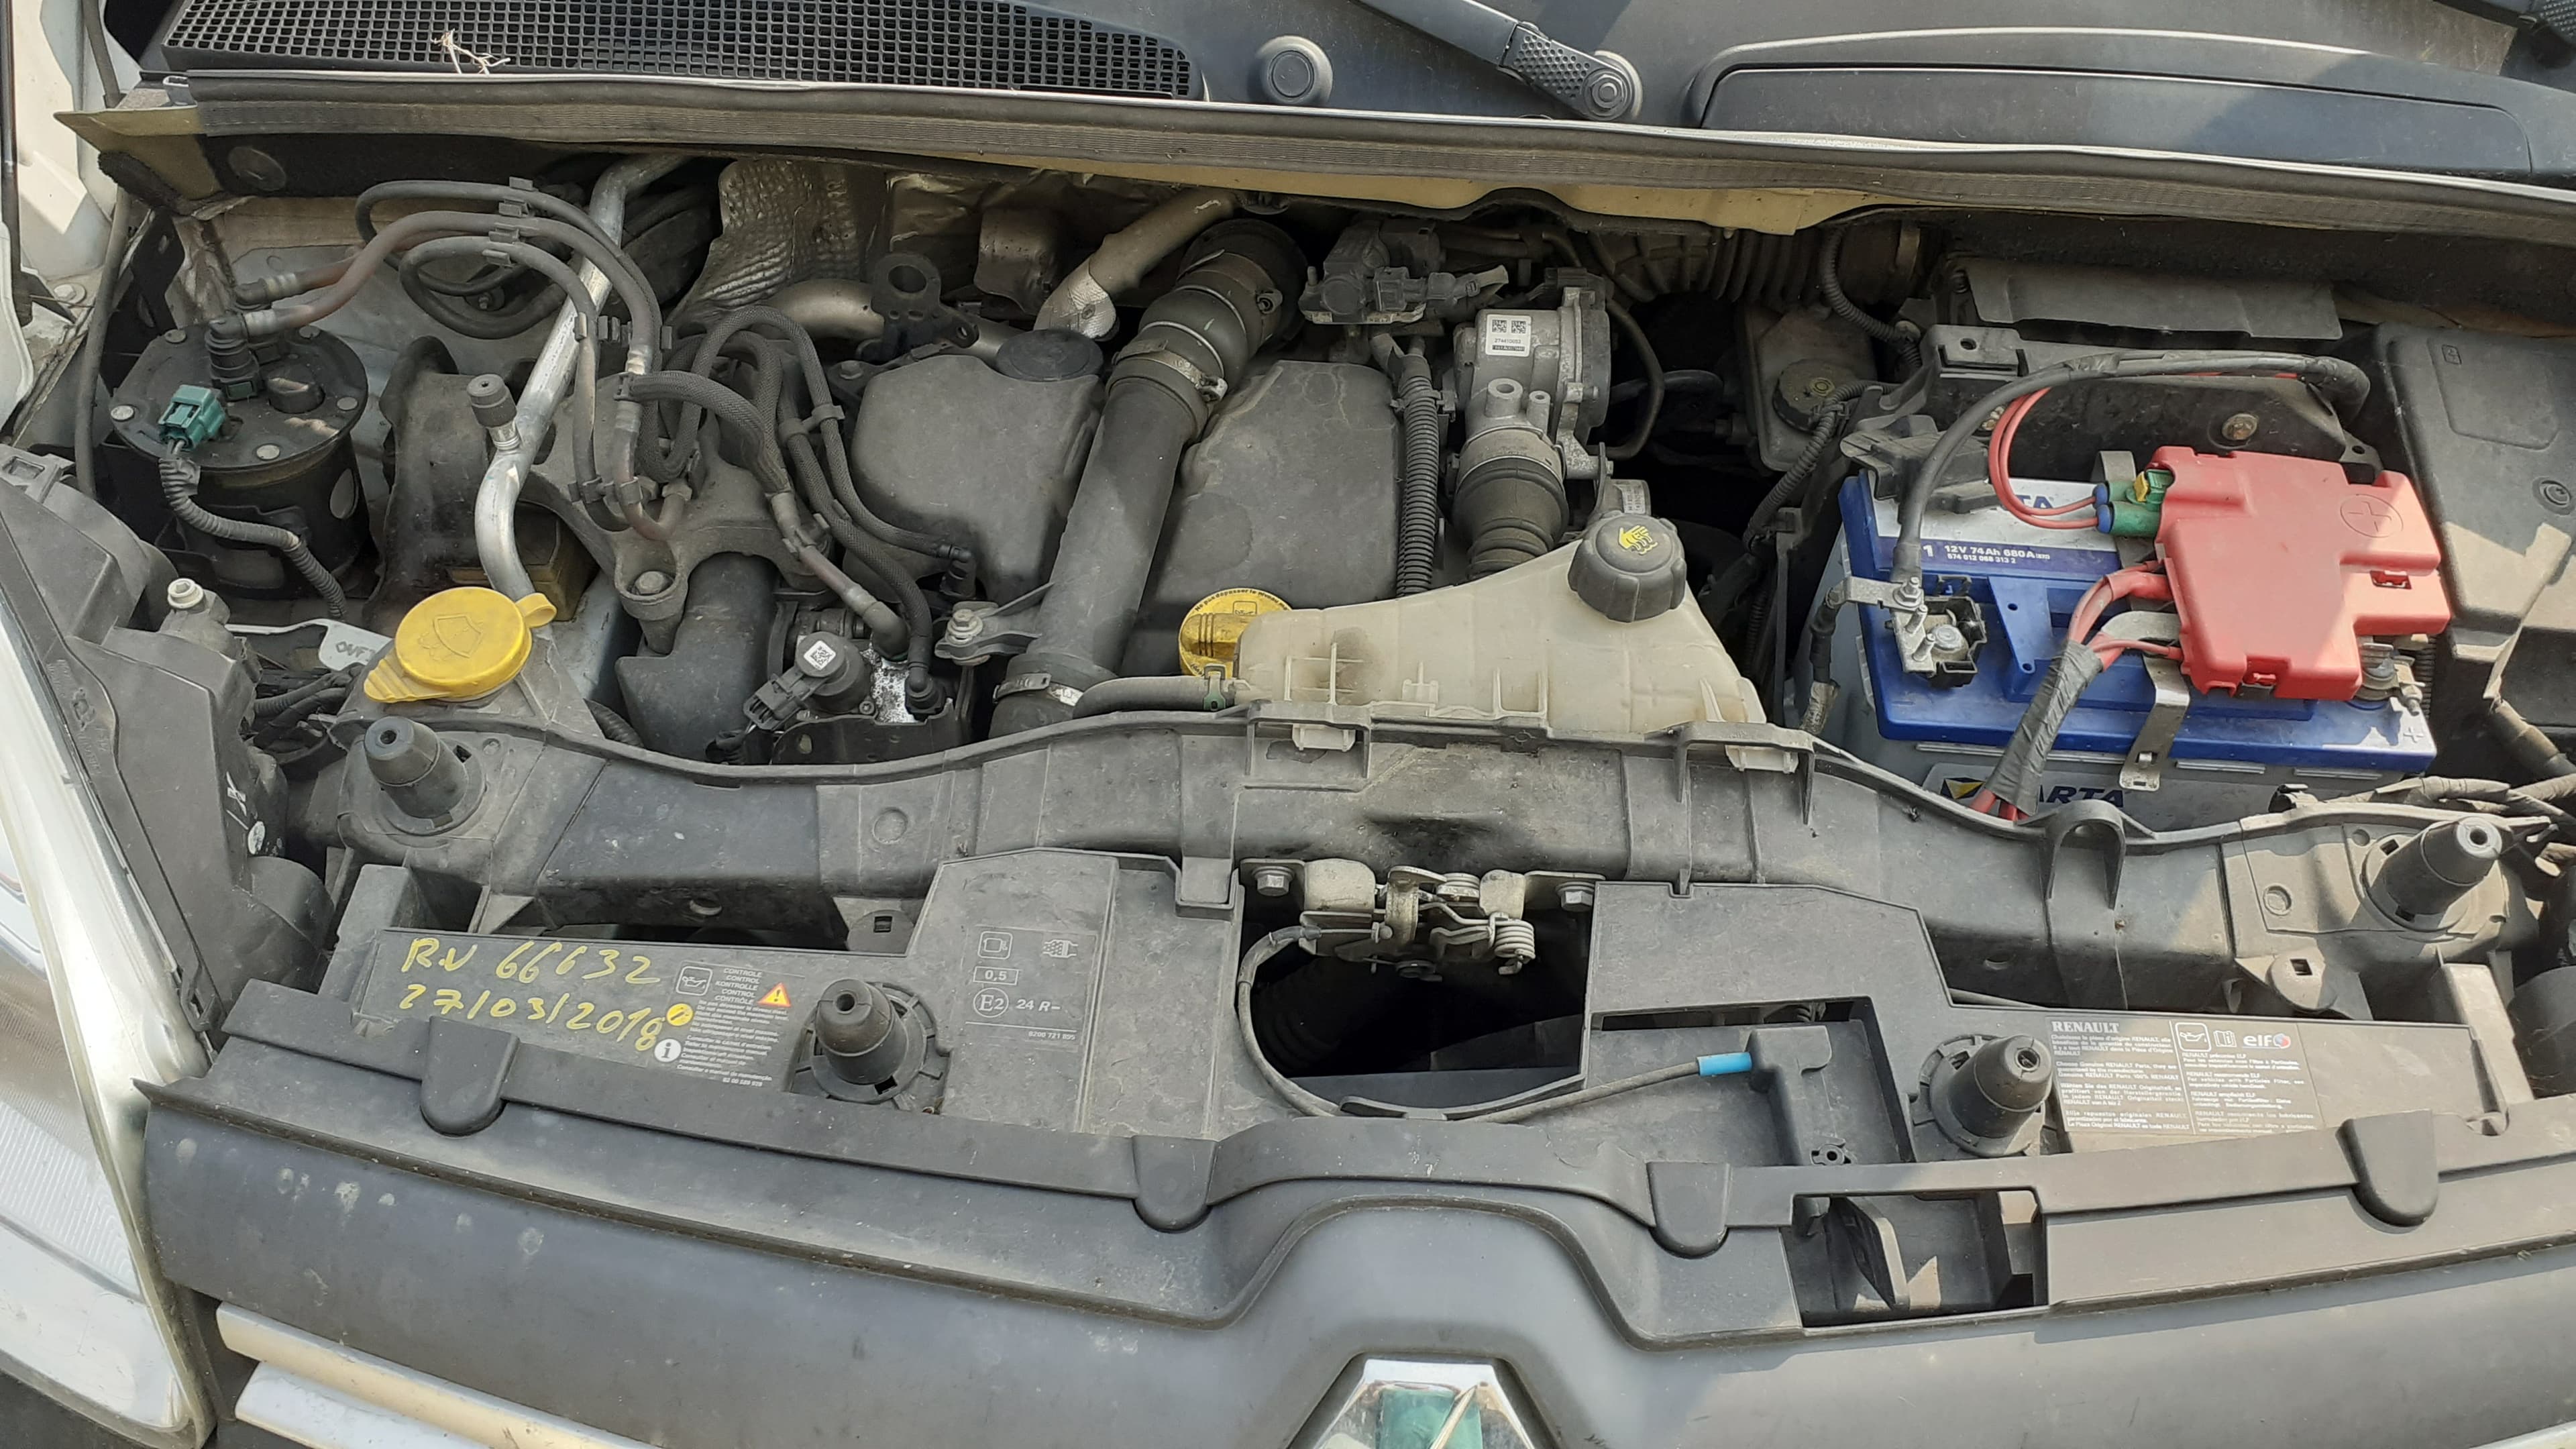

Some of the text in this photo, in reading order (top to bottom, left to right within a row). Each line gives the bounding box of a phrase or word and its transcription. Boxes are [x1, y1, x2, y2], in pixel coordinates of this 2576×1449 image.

[1945, 545, 1967, 553] 12V
[1970, 547, 2000, 555] 74Ah
[2039, 785, 2123, 807] RTA
[496, 940, 661, 984] 66632
[727, 975, 760, 984] CONTROL
[985, 970, 1007, 981] 0,5
[715, 981, 759, 991] KONTROLLE
[722, 989, 756, 998] CONTROL
[1016, 999, 1034, 1010] 24
[399, 983, 665, 1051] 27/03/2018
[2051, 1021, 2119, 1034] RENAULT
[2243, 1034, 2273, 1046] elf
